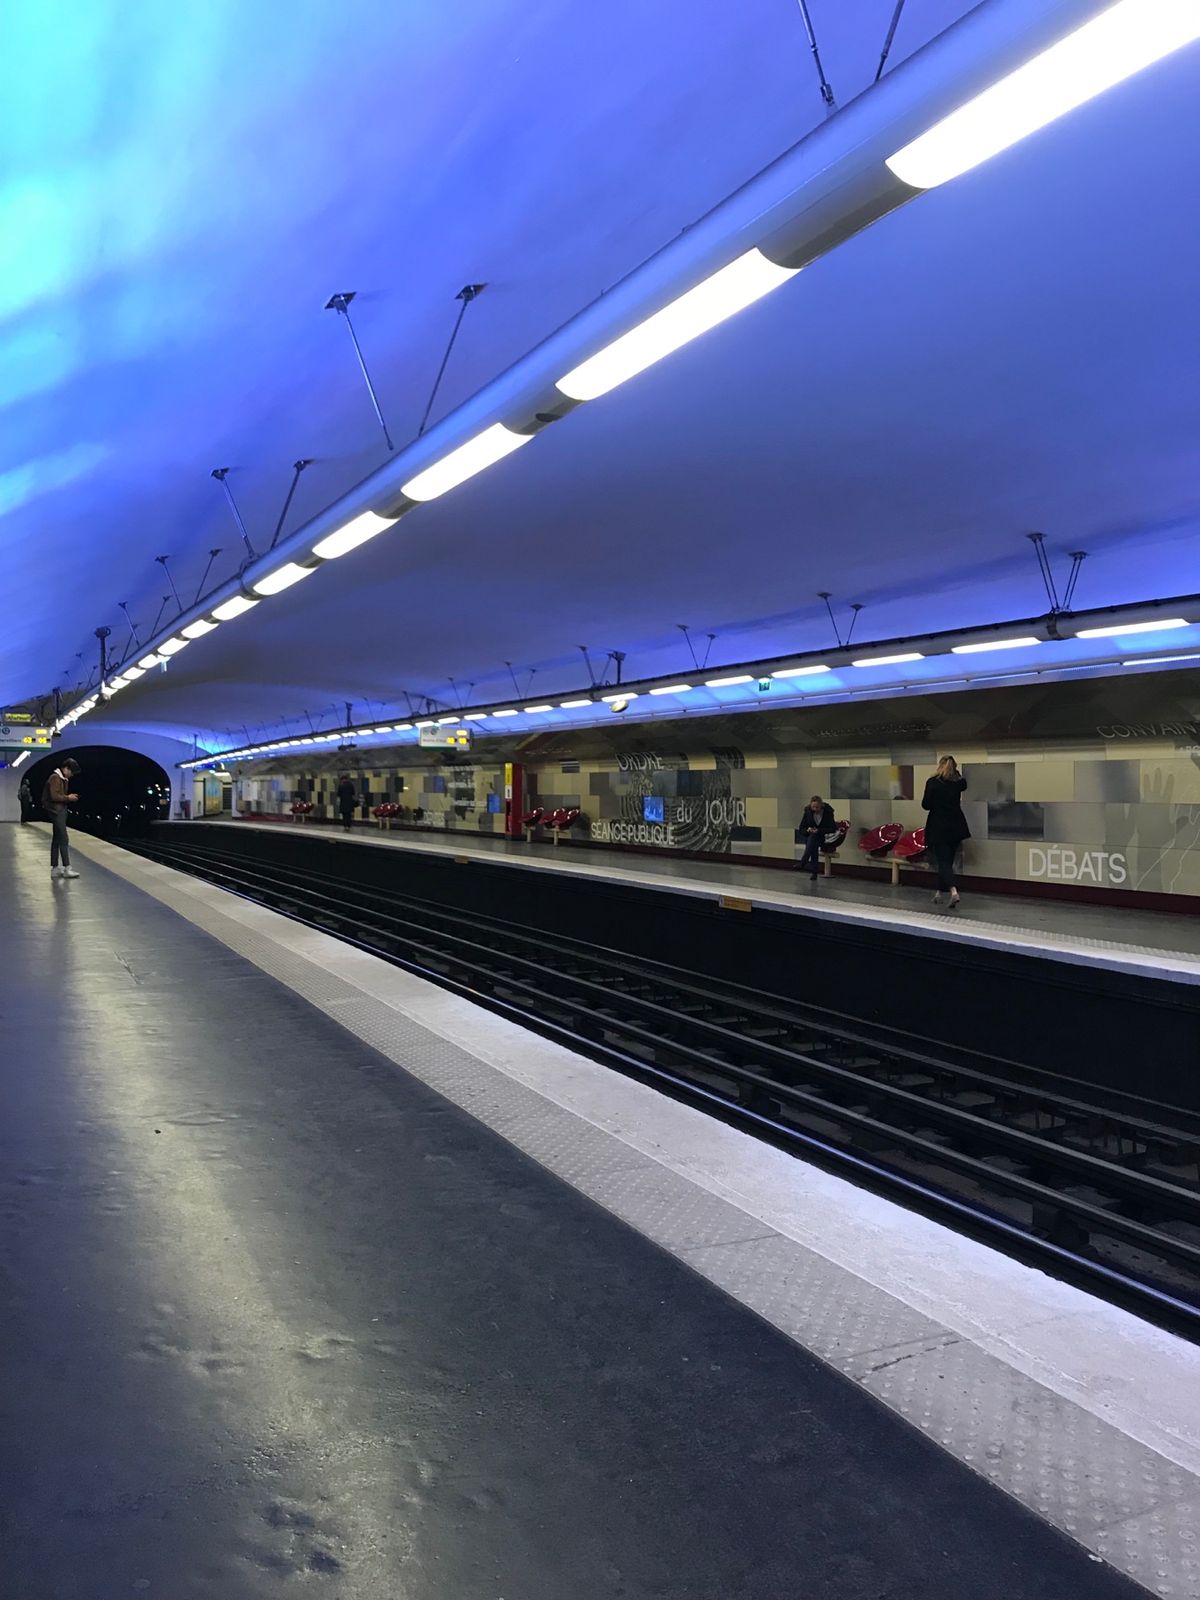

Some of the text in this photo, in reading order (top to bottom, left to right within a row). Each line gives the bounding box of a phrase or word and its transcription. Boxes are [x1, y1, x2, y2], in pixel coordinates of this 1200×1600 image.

[614, 751, 665, 771] ORDRE
[676, 799, 693, 823] du
[702, 799, 747, 834] JOUR
[590, 819, 675, 845] SÉANCE PUBLIQUE
[1028, 844, 1127, 883] DÉBATS
